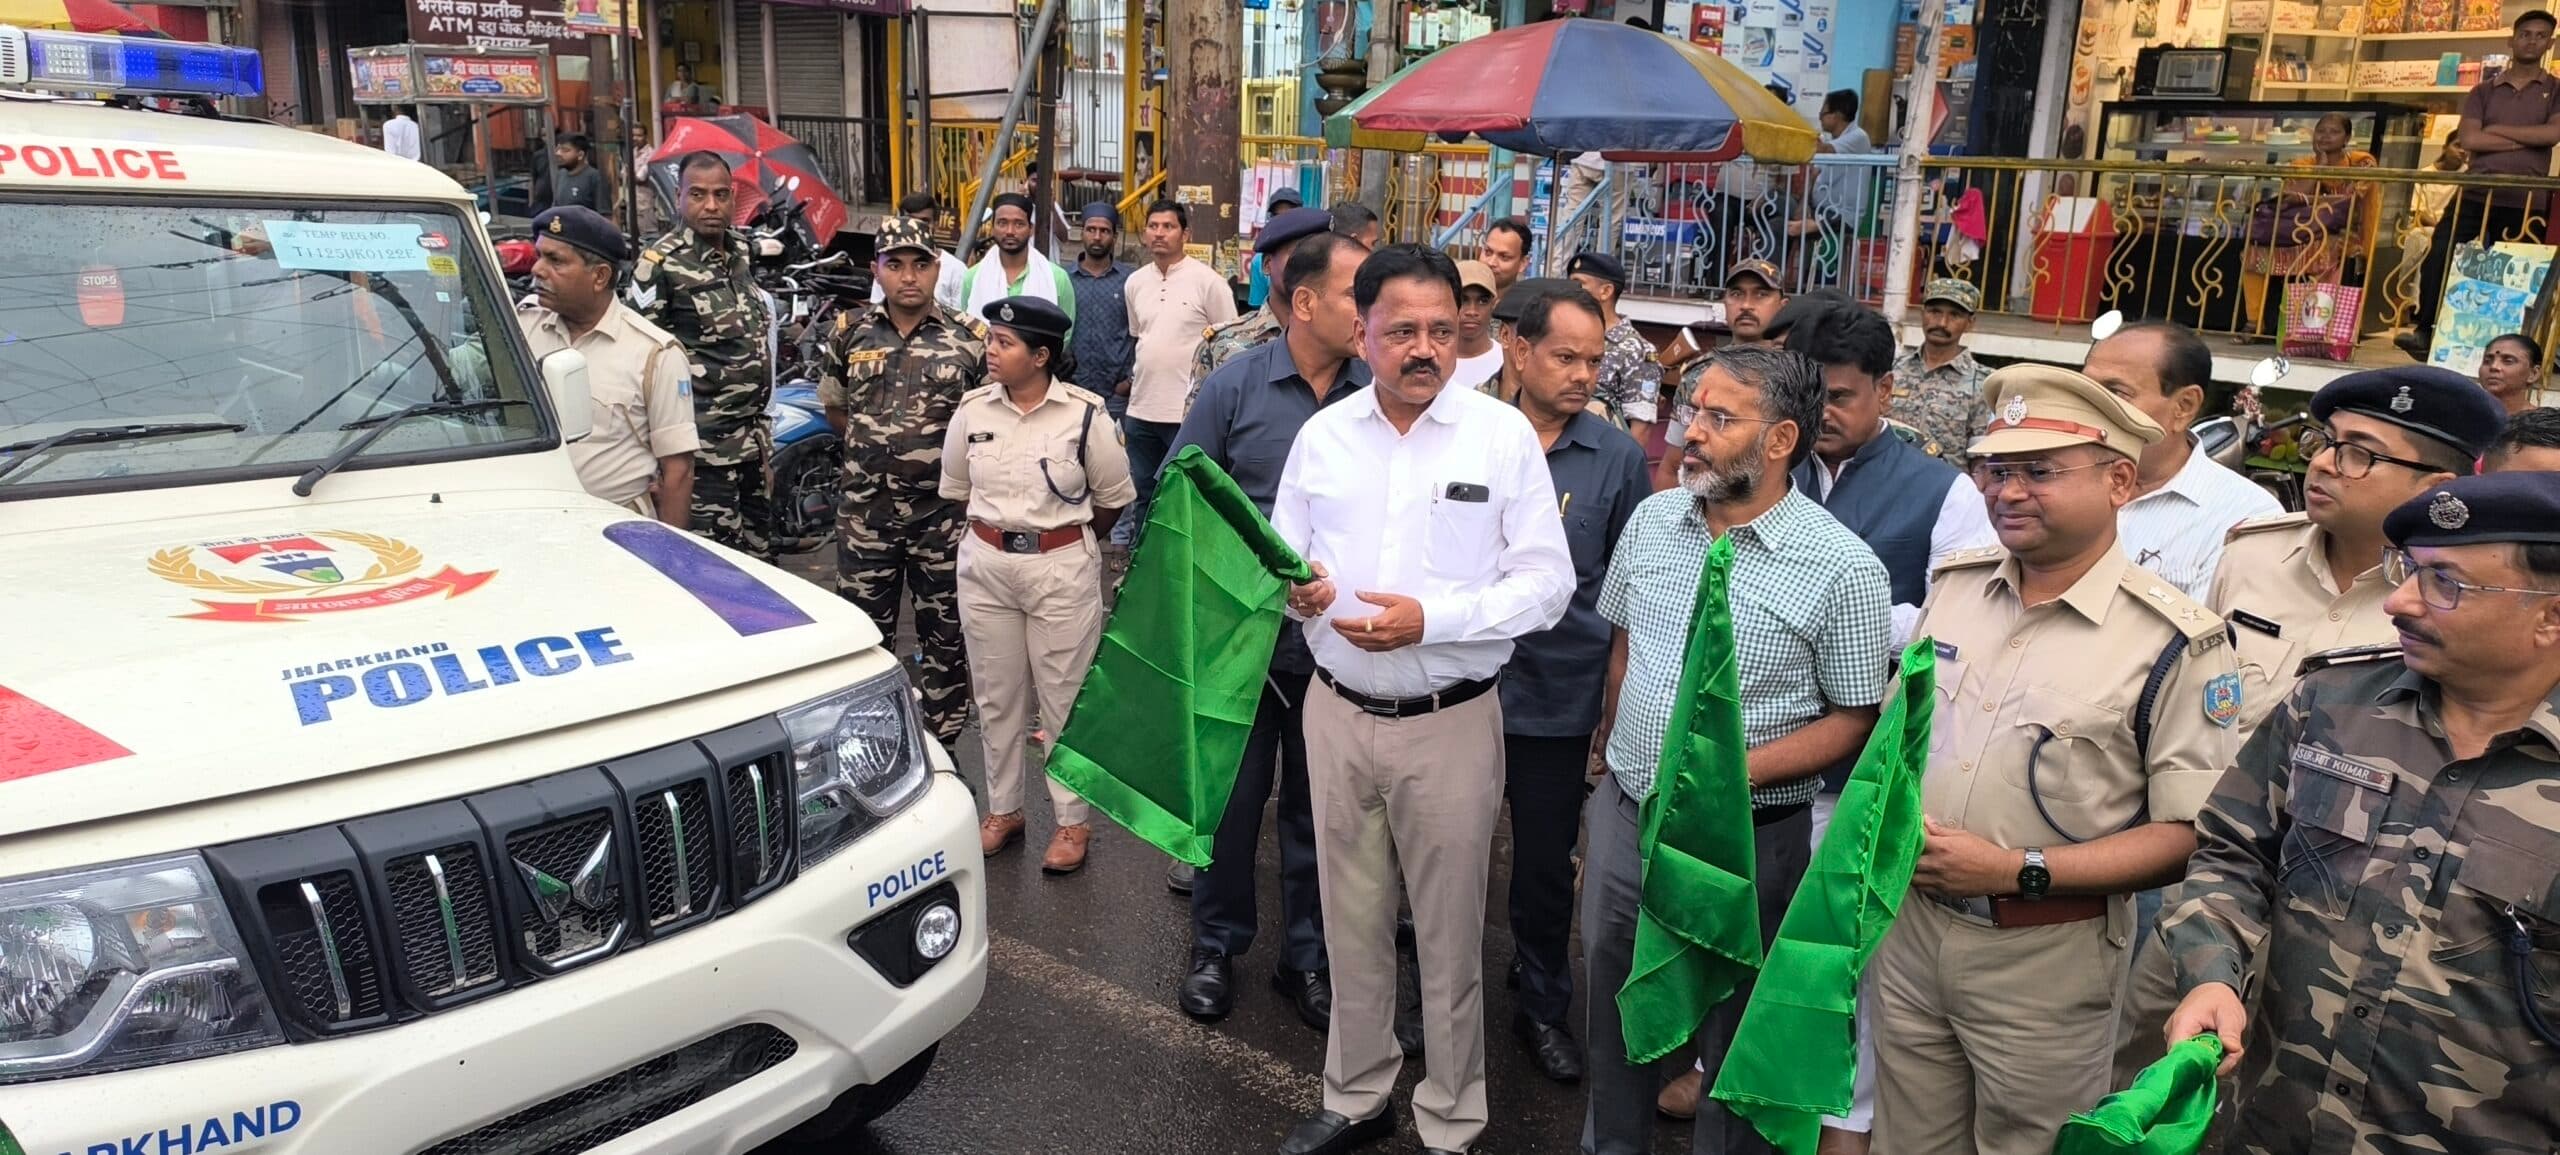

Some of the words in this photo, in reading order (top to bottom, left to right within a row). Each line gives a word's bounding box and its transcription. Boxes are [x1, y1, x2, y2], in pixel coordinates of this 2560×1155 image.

[455, 2, 477, 16] का
[428, 16, 473, 33] ATM
[0, 144, 187, 181] POLICE
[303, 229, 337, 240] TEMP
[281, 642, 450, 681] JHARKHAND
[289, 626, 635, 727] POLICE
[2332, 759, 2371, 780] KUMAR
[867, 850, 947, 908] POLICE
